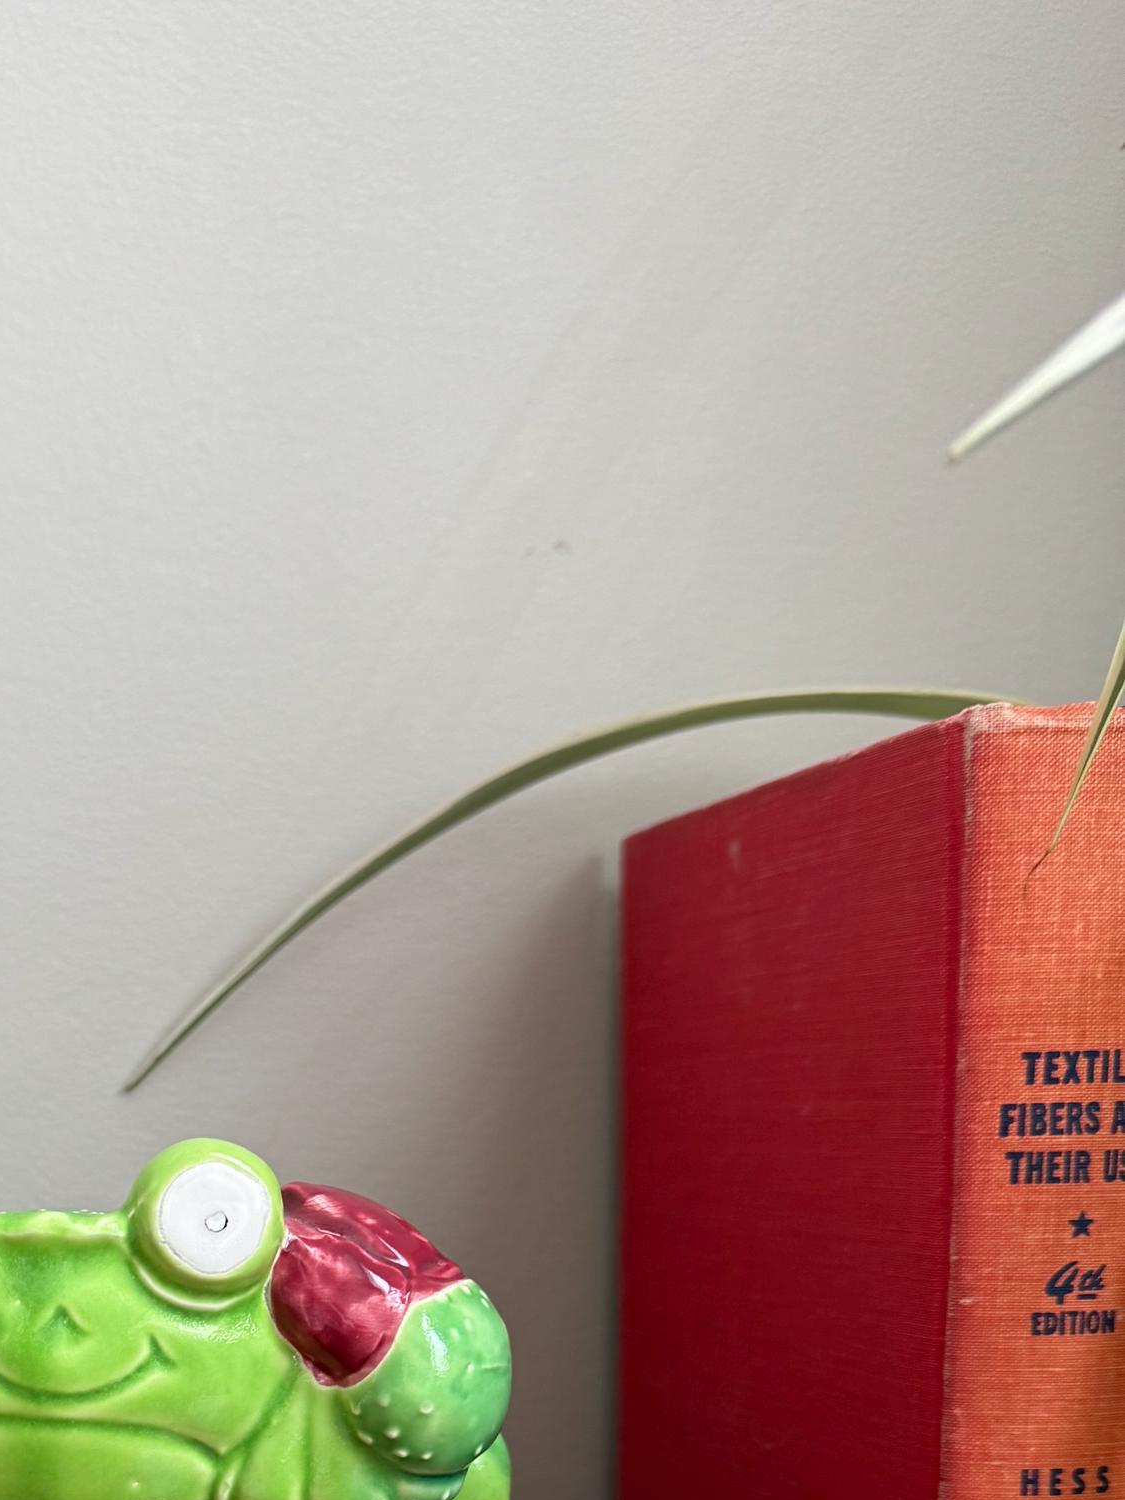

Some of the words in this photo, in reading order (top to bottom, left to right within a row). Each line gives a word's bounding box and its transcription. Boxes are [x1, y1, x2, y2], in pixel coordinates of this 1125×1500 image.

[1021, 1049, 1125, 1085] TEXTIL
[998, 1101, 1101, 1138] FIBERS
[1004, 1150, 1091, 1185] THEIR
[1045, 1260, 1107, 1305] 4th
[1030, 1310, 1116, 1336] EDITION
[1020, 1465, 1109, 1496] HESS
